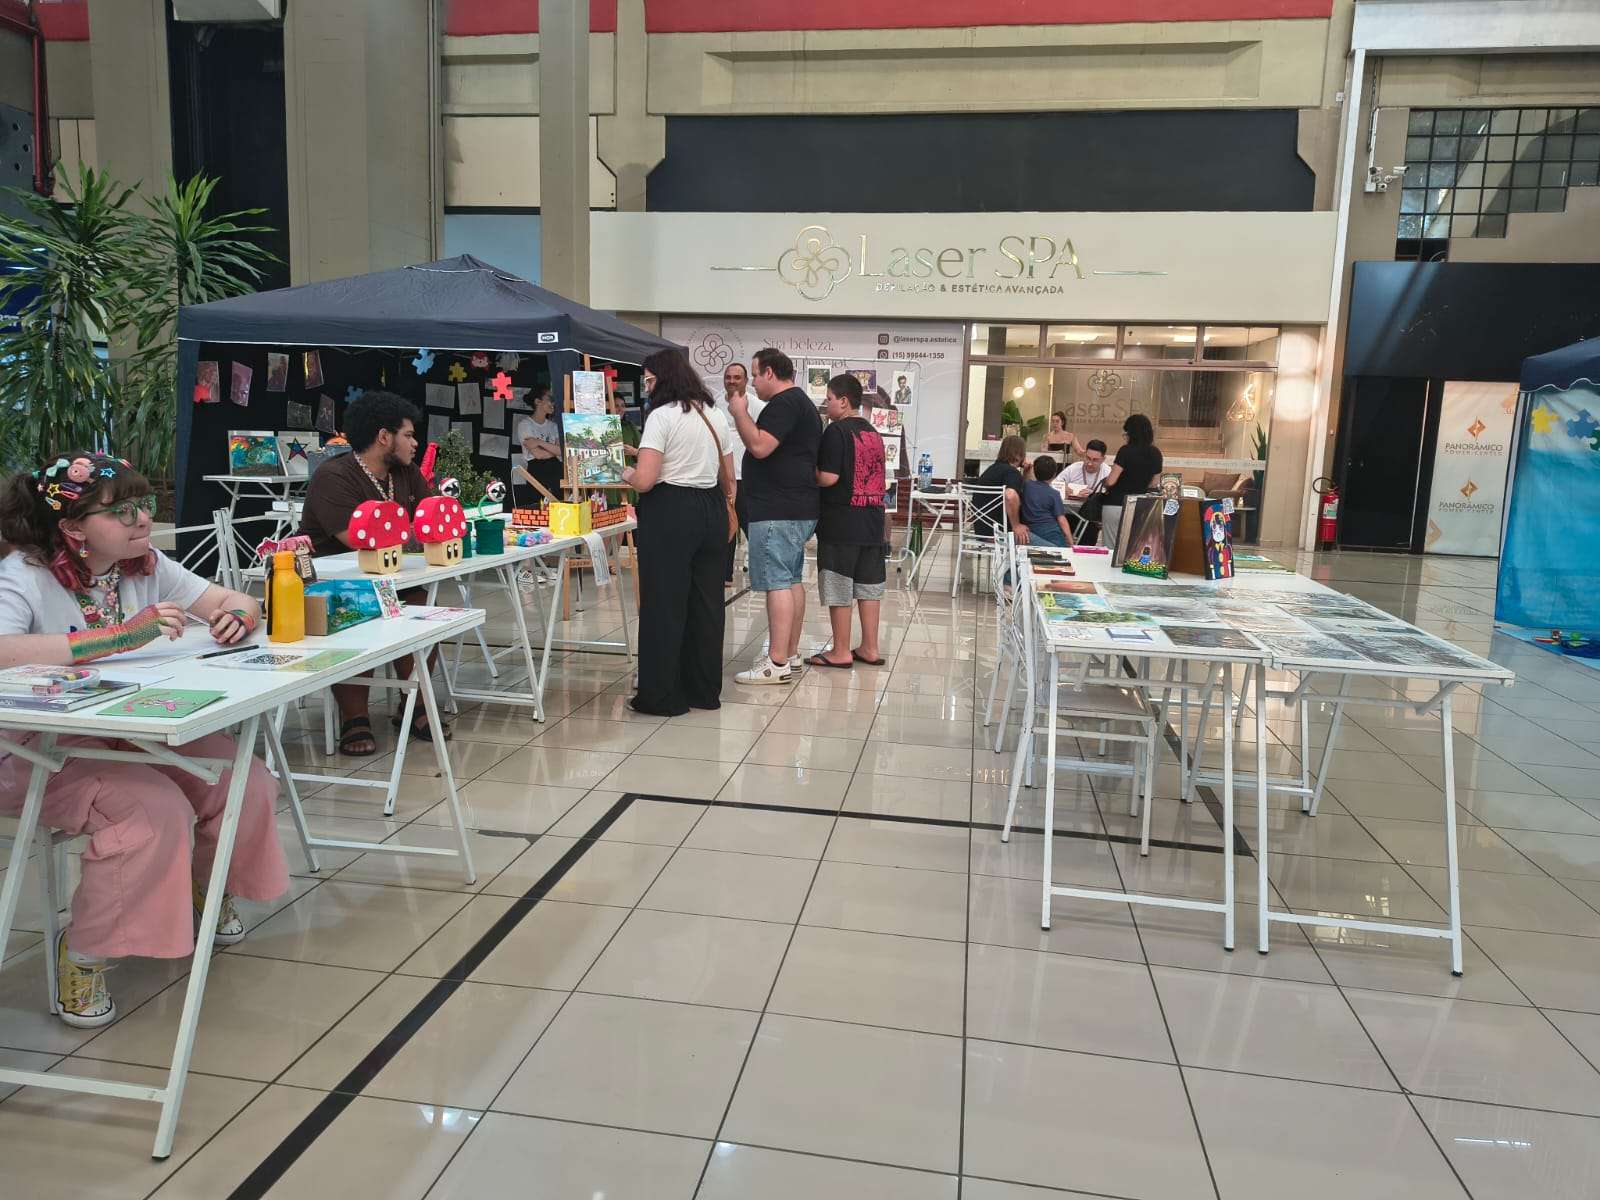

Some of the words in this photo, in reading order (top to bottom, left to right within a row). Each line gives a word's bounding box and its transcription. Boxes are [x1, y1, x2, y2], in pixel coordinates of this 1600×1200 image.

[857, 234, 987, 279] Laser
[995, 235, 1086, 280] SPA
[940, 284, 947, 293] &
[951, 282, 1002, 293] ESTÉTICA
[1003, 285, 1064, 295] AVANÇADA
[1064, 402, 1110, 417] aser
[1445, 441, 1503, 451] PANORÂMICO
